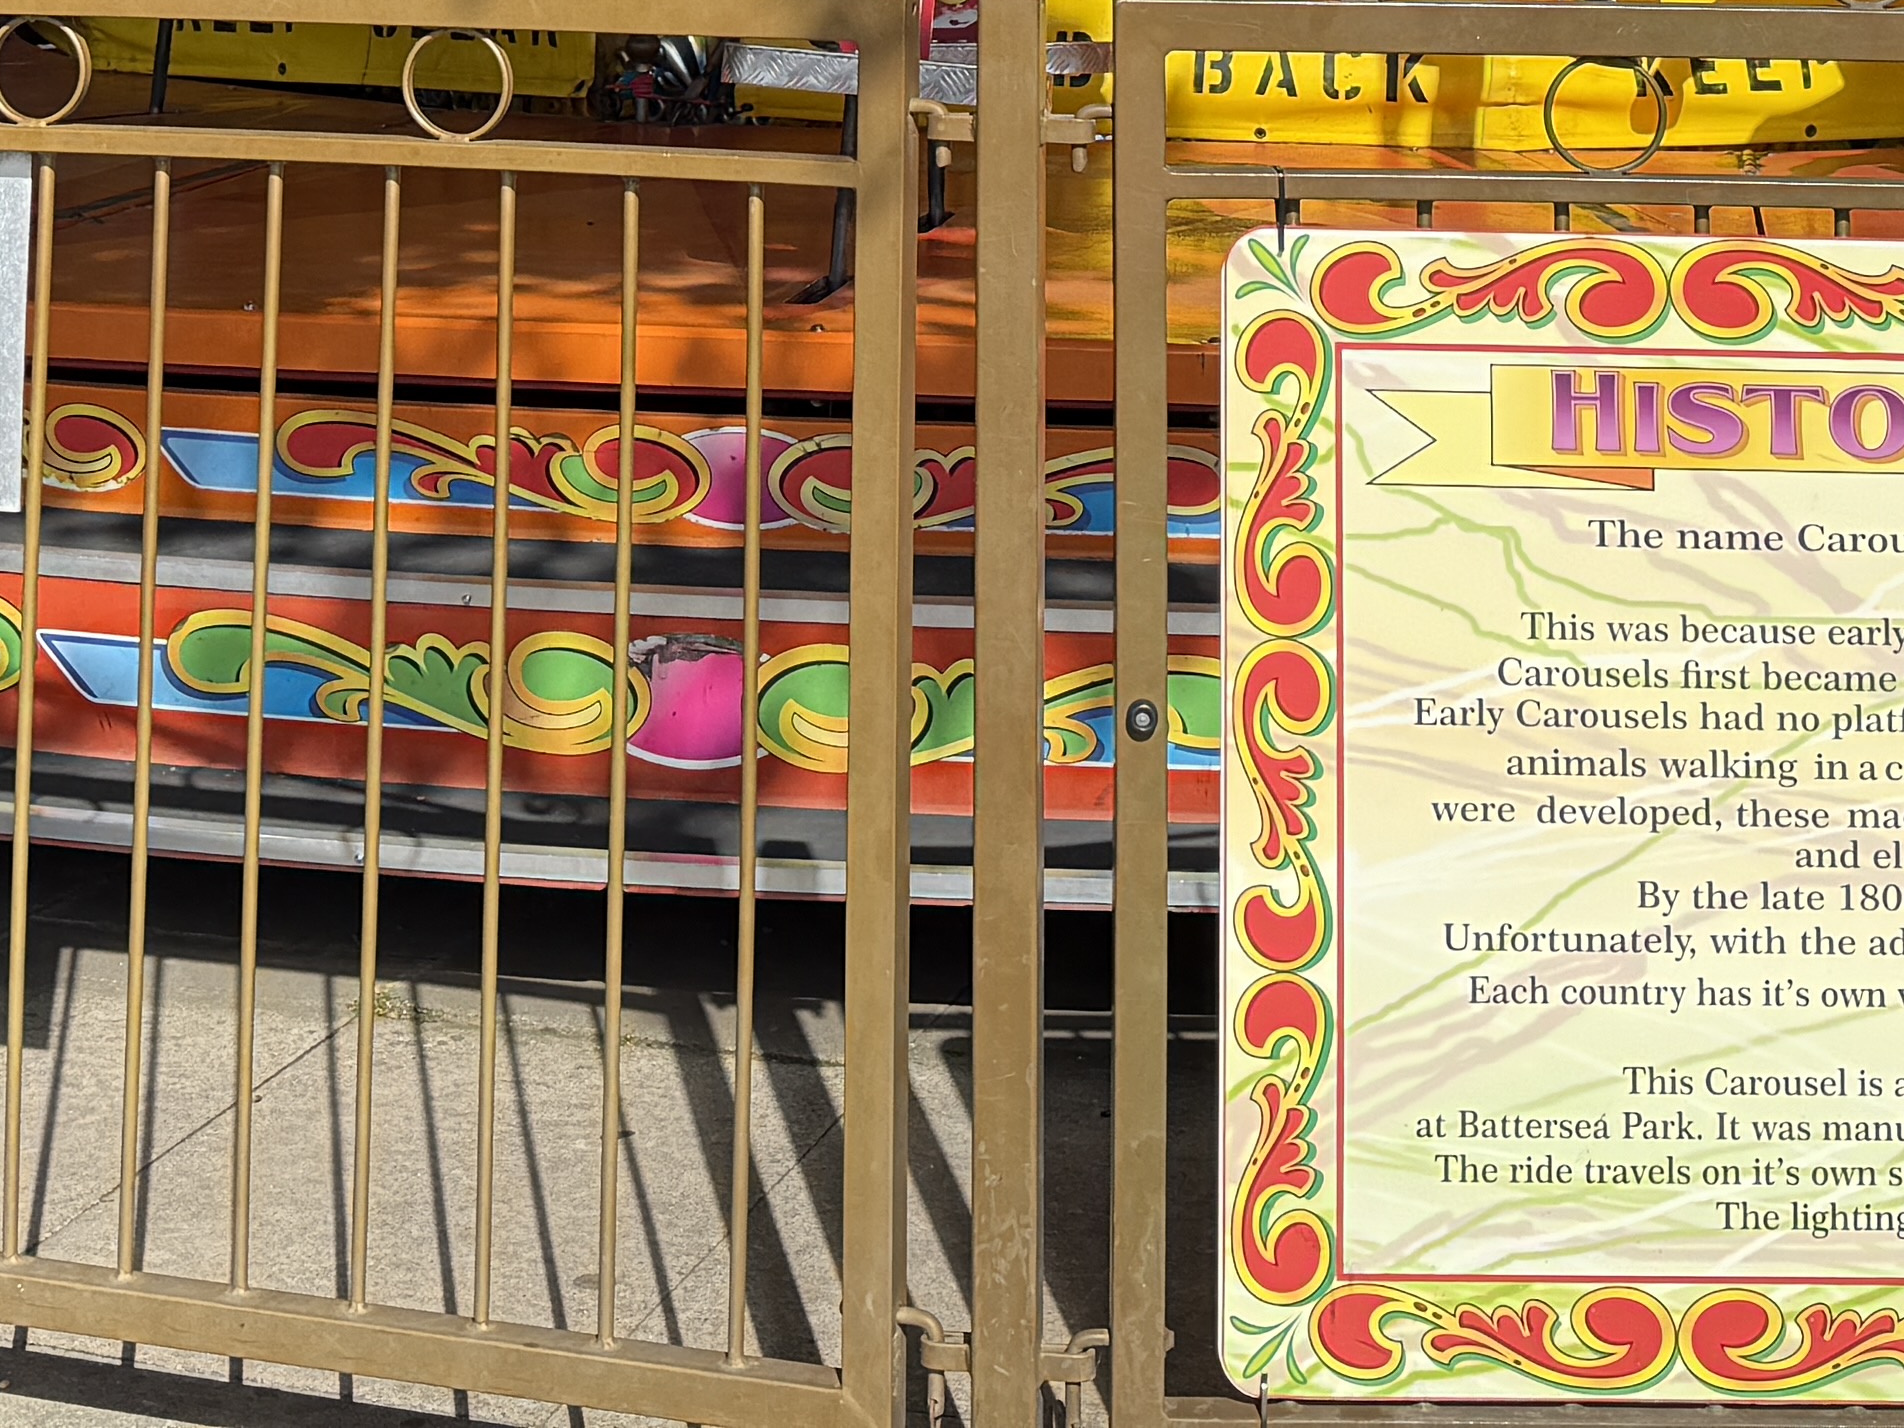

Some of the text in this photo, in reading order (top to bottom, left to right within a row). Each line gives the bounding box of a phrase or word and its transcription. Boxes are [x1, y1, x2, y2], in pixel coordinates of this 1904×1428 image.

[1192, 50, 1430, 104] BACK
[1587, 519, 1663, 549] The
[1676, 529, 1784, 552] name
[1431, 802, 1516, 823] were
[1536, 794, 1722, 834] developed,
[1736, 798, 1830, 829] these
[1795, 839, 1861, 869] and
[1637, 880, 1680, 917] By
[1692, 880, 1749, 910] the
[1760, 880, 1825, 911] late
[1443, 922, 1696, 962] Unfortunately,
[1709, 925, 1787, 955] with
[1800, 926, 1856, 956] the
[1622, 1065, 1694, 1096] This
[1705, 1066, 1847, 1097] Carousel
[1858, 1069, 1883, 1097] is
[1715, 1201, 1780, 1231] The
